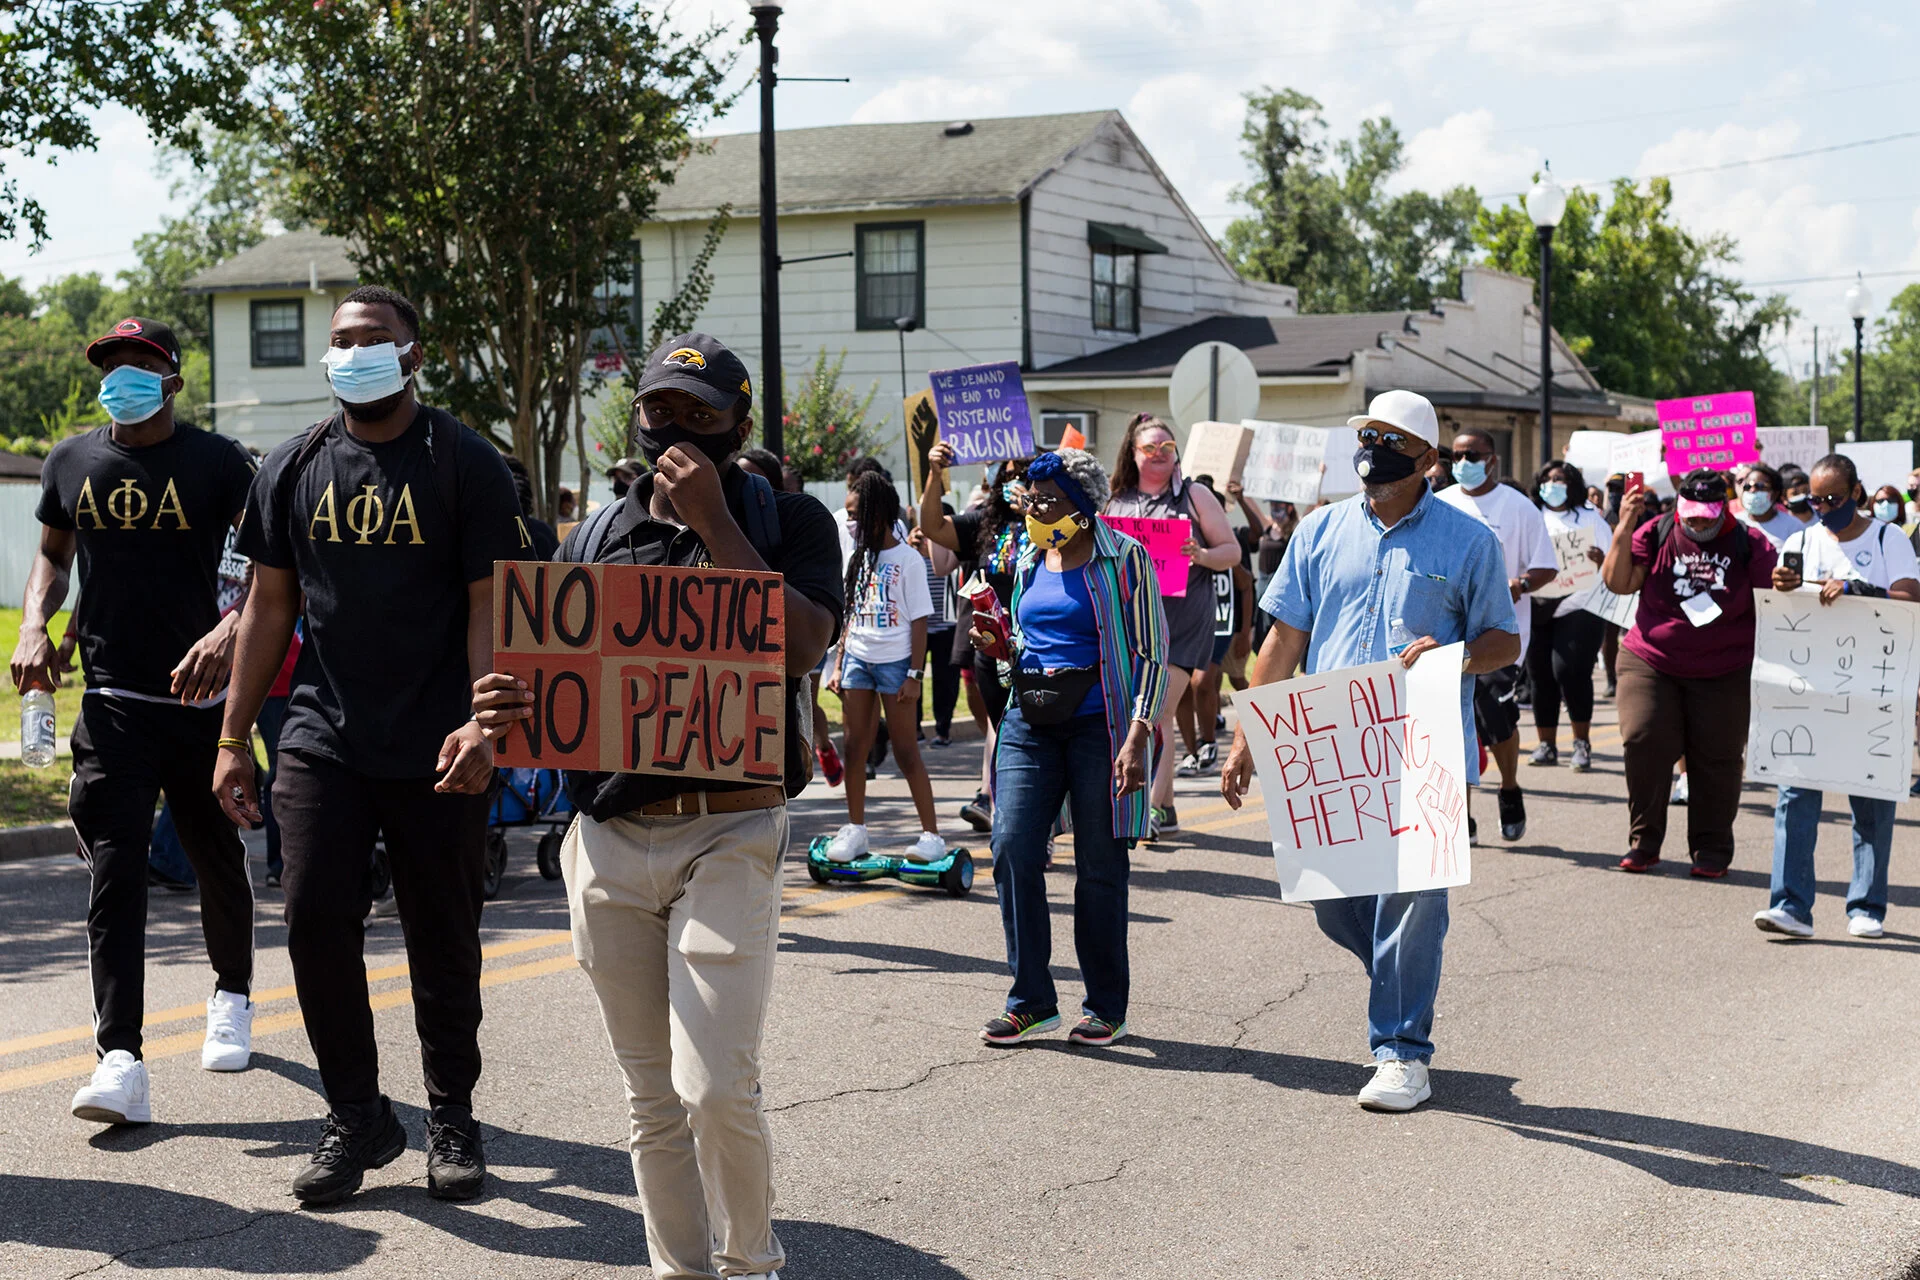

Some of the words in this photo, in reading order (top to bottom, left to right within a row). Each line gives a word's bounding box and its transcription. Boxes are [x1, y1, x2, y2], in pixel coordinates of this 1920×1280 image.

[937, 376, 955, 389] WE
[961, 370, 1005, 387] DEMAND
[942, 393, 956, 405] AN
[962, 389, 982, 404] END
[986, 388, 1001, 400] TO
[947, 407, 1012, 428] SYSTEMIC
[948, 427, 1025, 459] RACISM
[1133, 520, 1144, 532] TO
[1152, 522, 1171, 534] KILL
[1153, 559, 1166, 572] ST
[502, 563, 599, 648] NO
[613, 573, 781, 654] JUSTICE
[497, 668, 589, 760] NO
[620, 662, 782, 781] PEACE
[1250, 685, 1338, 740] WE
[1349, 673, 1410, 729] ALL
[1274, 718, 1430, 792] BELONG
[1286, 779, 1419, 849] HERE.
